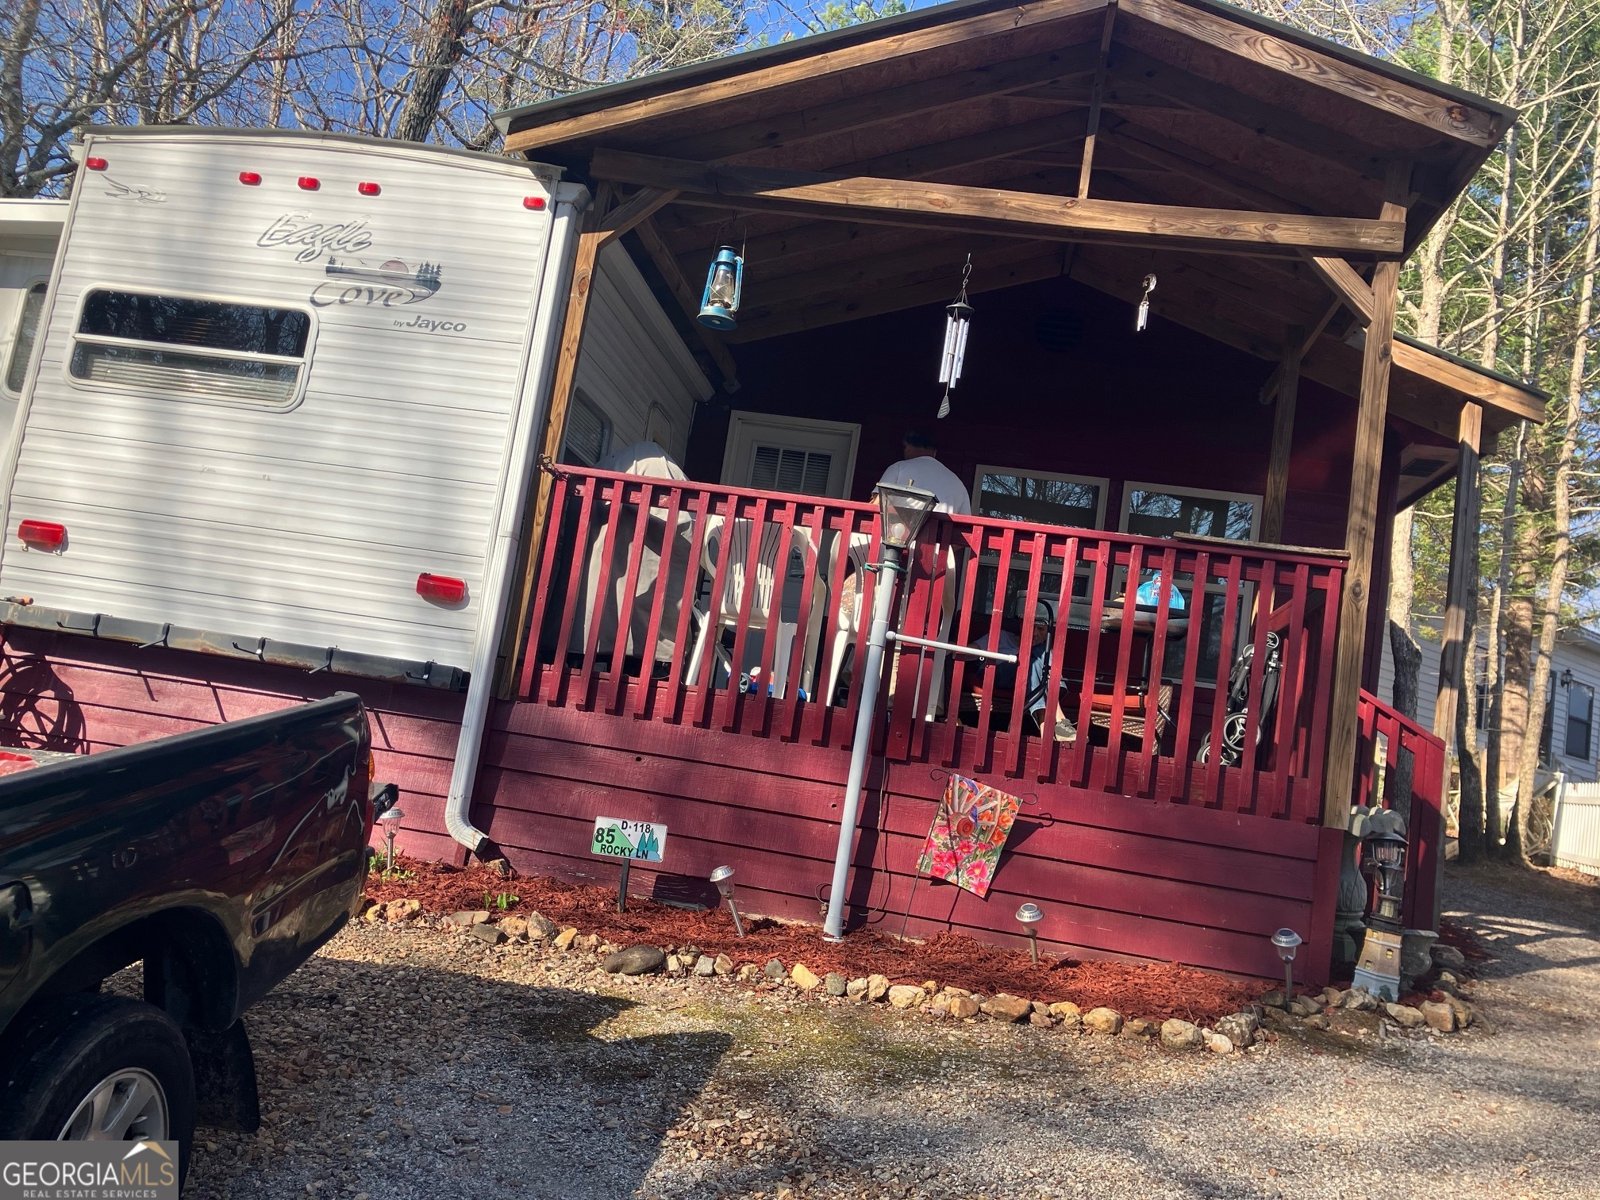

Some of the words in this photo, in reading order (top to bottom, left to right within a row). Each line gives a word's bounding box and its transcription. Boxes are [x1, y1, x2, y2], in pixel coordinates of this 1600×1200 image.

[256, 209, 373, 262] Eagle
[309, 281, 403, 308] Cove
[393, 319, 405, 328] by
[406, 315, 466, 332] Jayco
[595, 827, 616, 844] 85
[600, 844, 634, 857] ROCKY
[635, 848, 649, 860] LN
